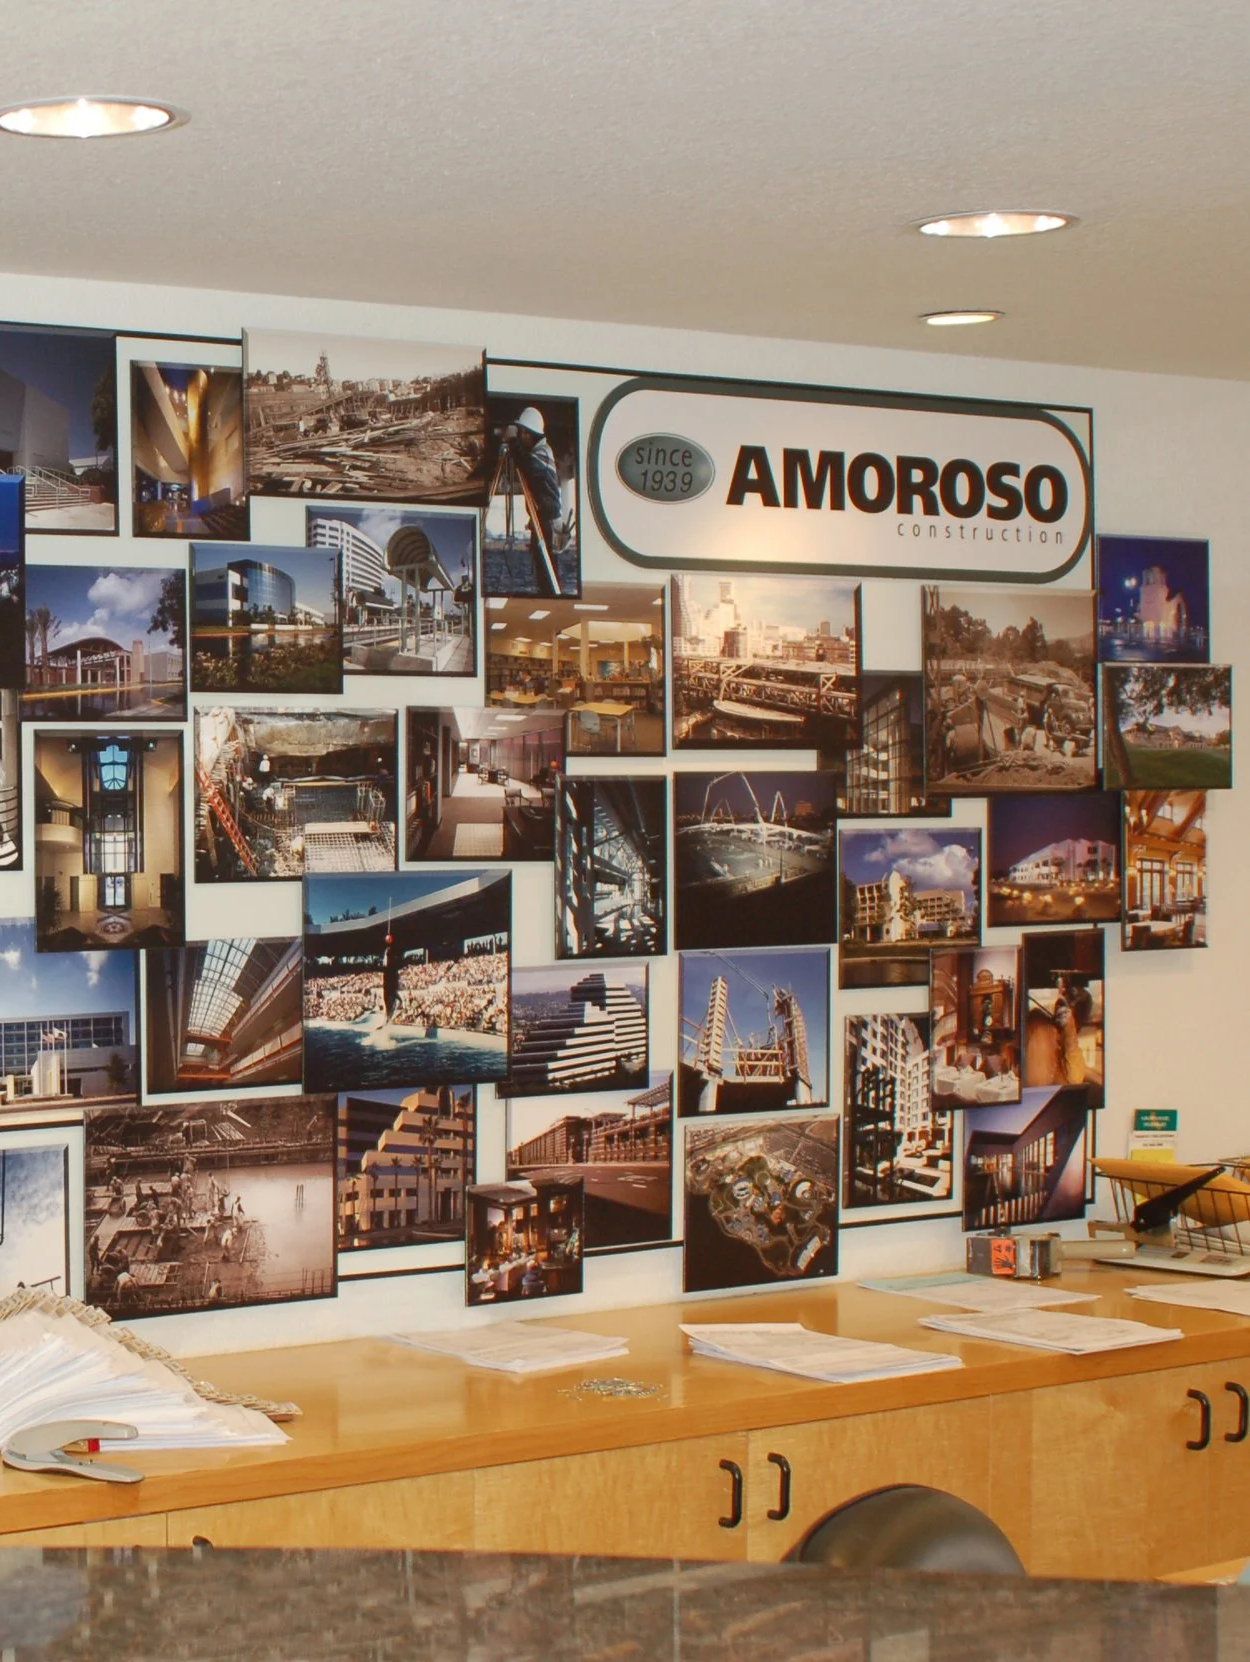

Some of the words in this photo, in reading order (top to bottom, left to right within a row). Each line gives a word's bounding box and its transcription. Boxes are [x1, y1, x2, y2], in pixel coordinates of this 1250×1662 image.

[635, 441, 692, 467] since
[640, 469, 693, 493] 1939
[726, 445, 1068, 524] AMOROSO
[897, 522, 1063, 544] construction
